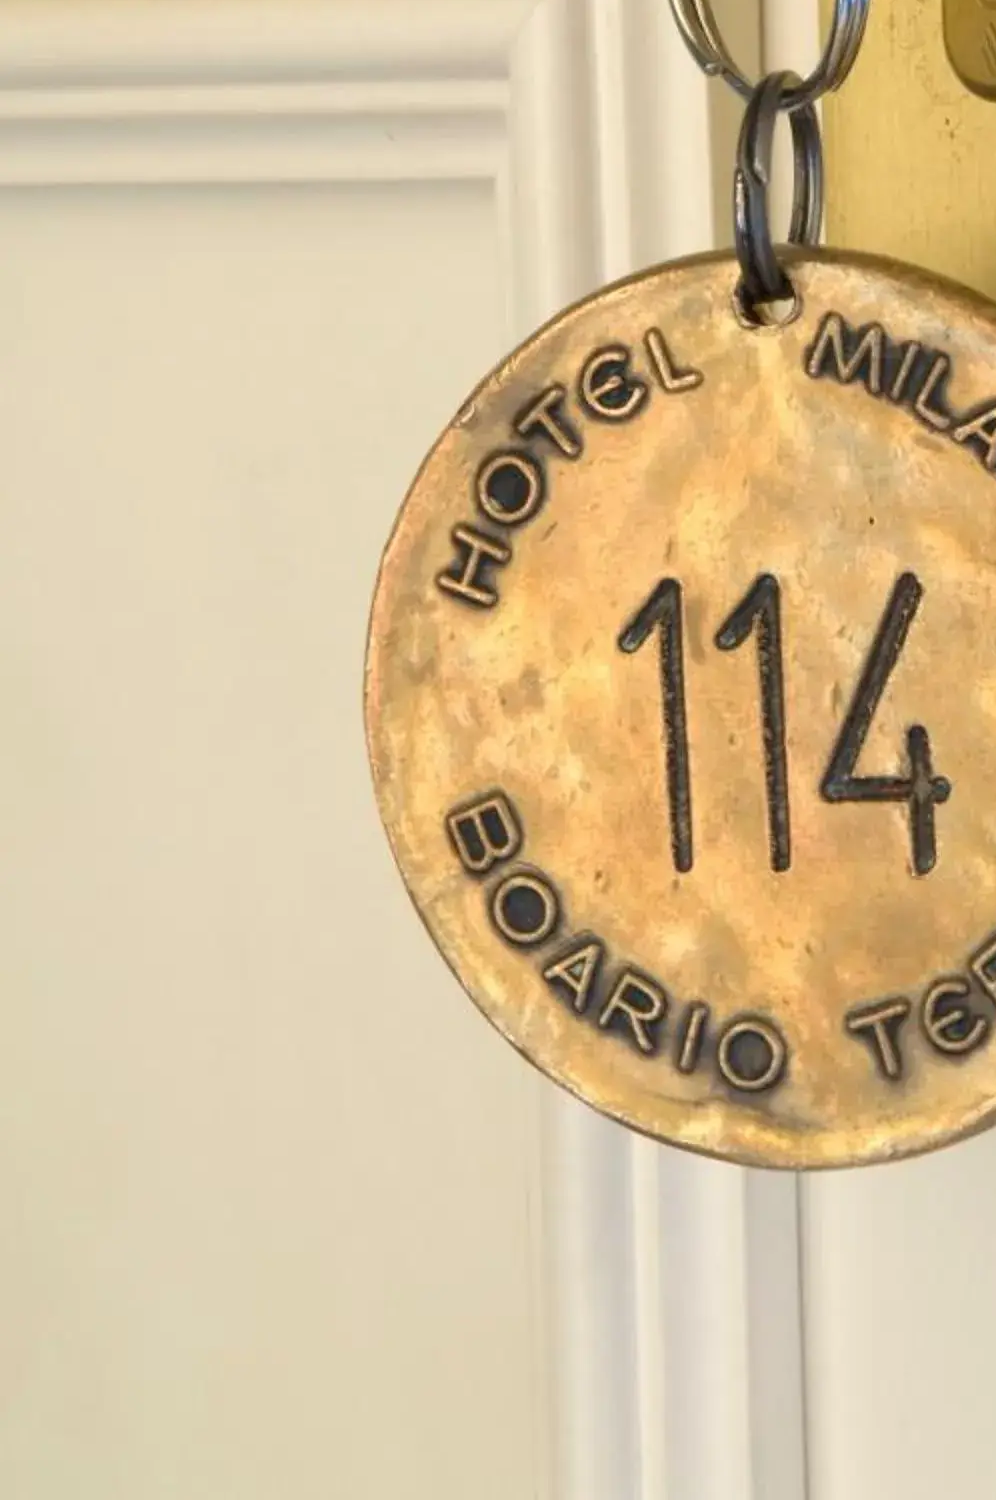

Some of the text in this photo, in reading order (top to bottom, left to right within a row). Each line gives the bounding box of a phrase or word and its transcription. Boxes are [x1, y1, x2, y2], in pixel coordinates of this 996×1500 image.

[437, 328, 702, 611] HOTEL
[618, 572, 950, 875] 114
[446, 789, 787, 1092] BOARIO
